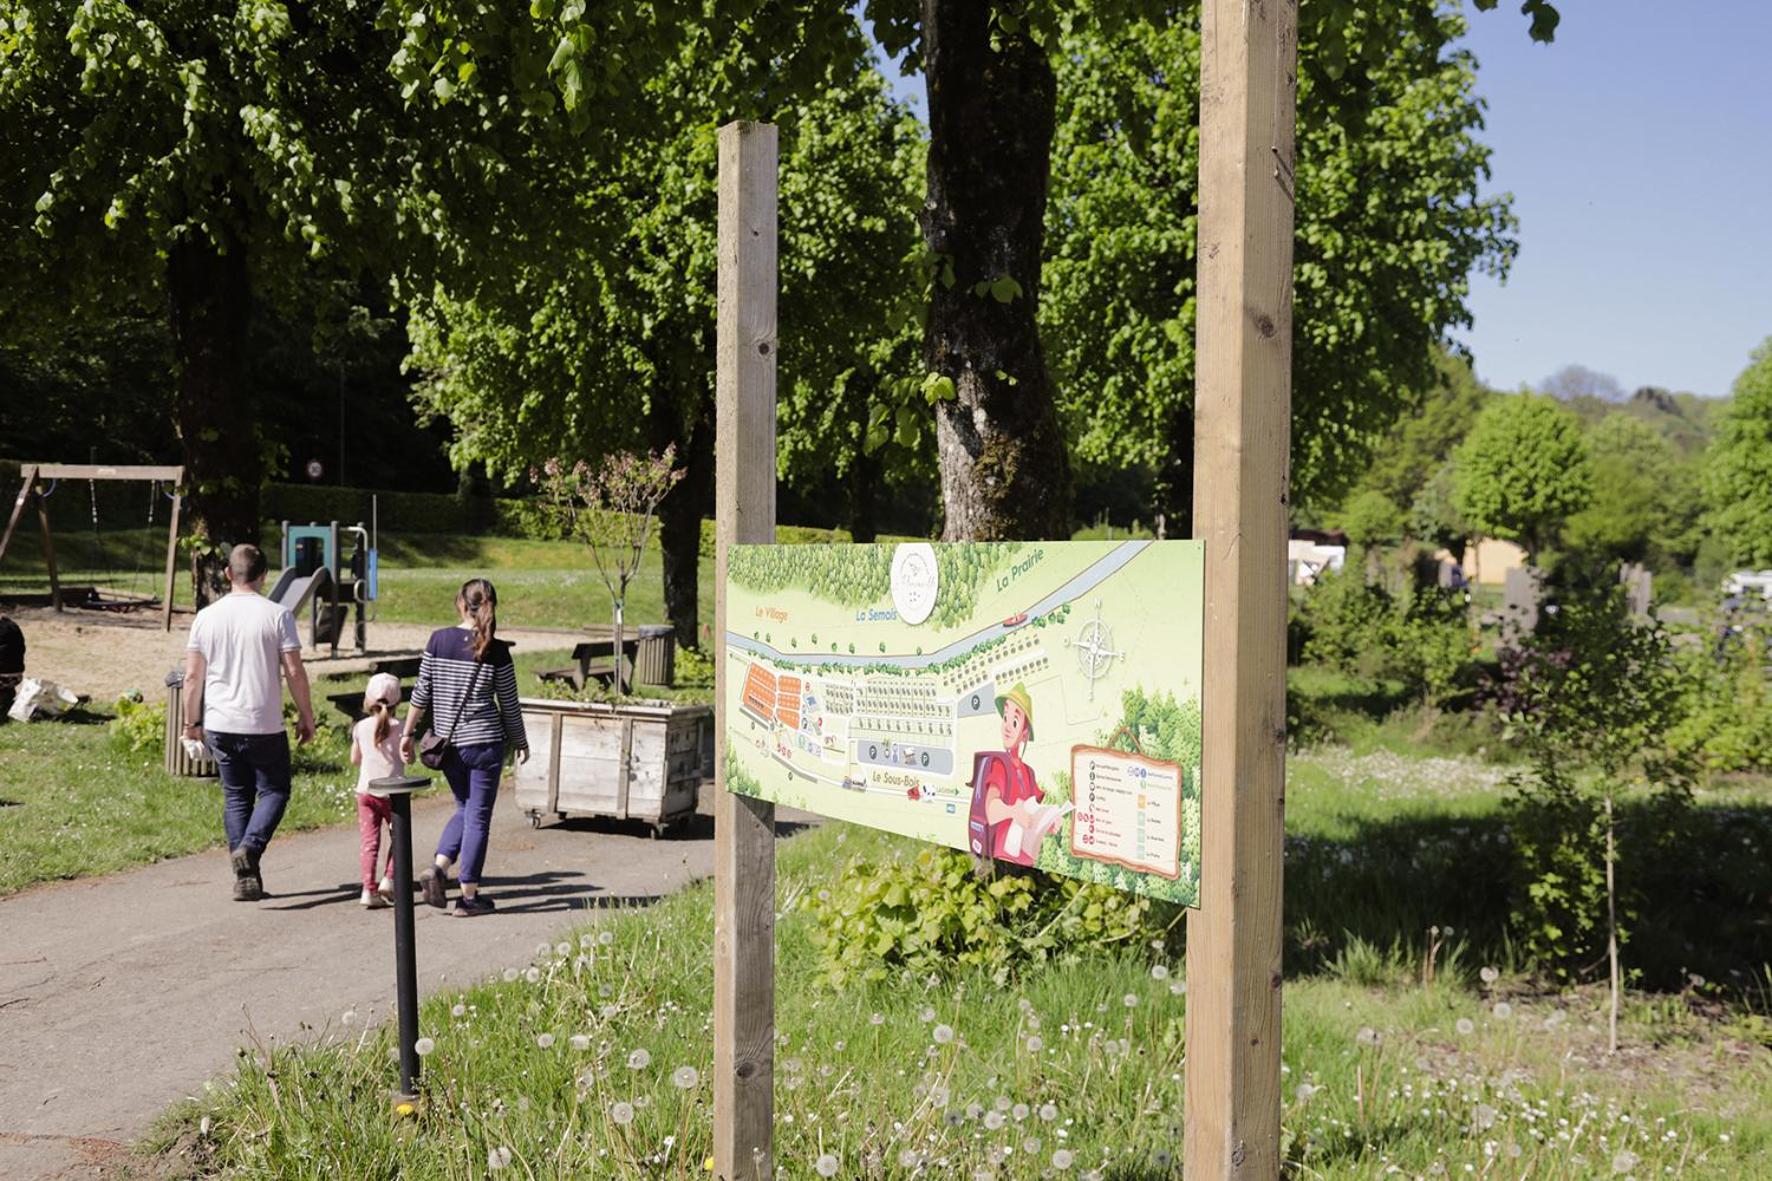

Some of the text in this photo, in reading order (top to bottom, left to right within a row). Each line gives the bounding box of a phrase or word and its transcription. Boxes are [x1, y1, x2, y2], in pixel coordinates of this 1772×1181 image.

[997, 549, 1043, 592] La Prairie
[766, 607, 789, 624] Village
[856, 611, 865, 621] La
[872, 771, 881, 782] Le
